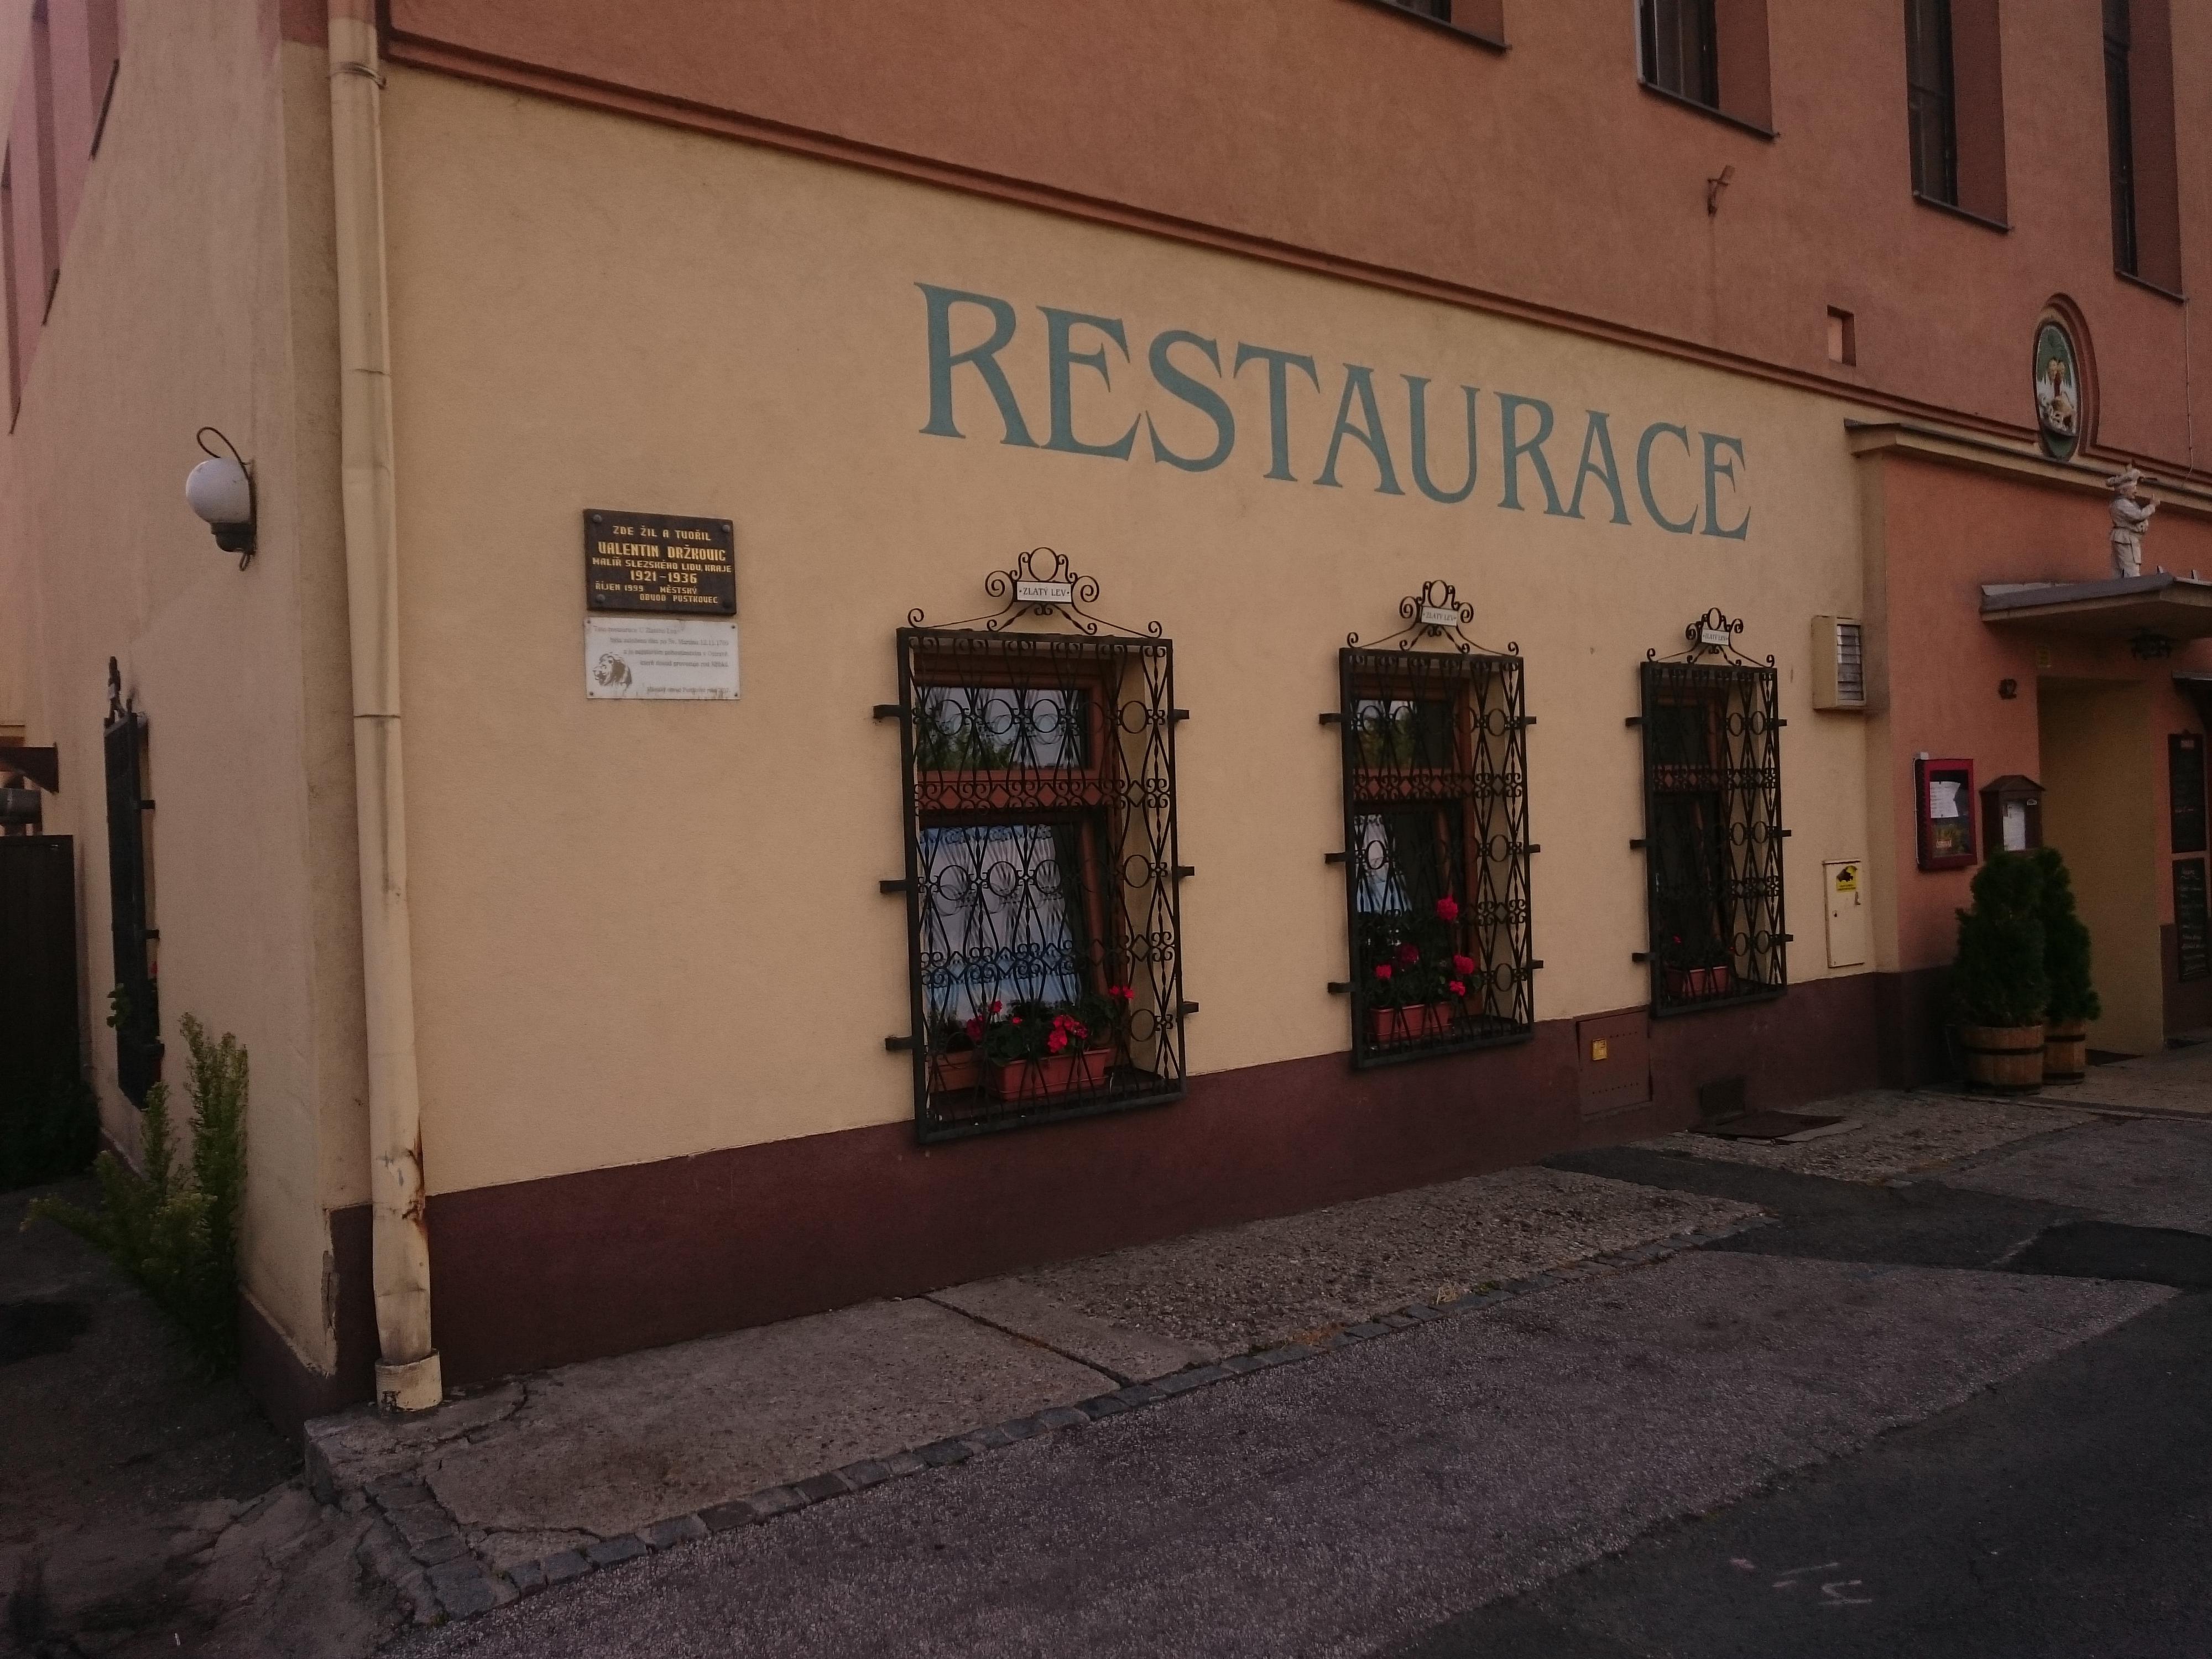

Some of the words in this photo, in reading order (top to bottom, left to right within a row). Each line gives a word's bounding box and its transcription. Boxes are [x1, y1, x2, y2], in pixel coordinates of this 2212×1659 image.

[912, 282, 1752, 541] RESTAURACE
[613, 525, 634, 535] ZDE
[640, 525, 658, 537] ŽIL
[662, 529, 669, 538] A
[624, 584, 644, 592] 1999
